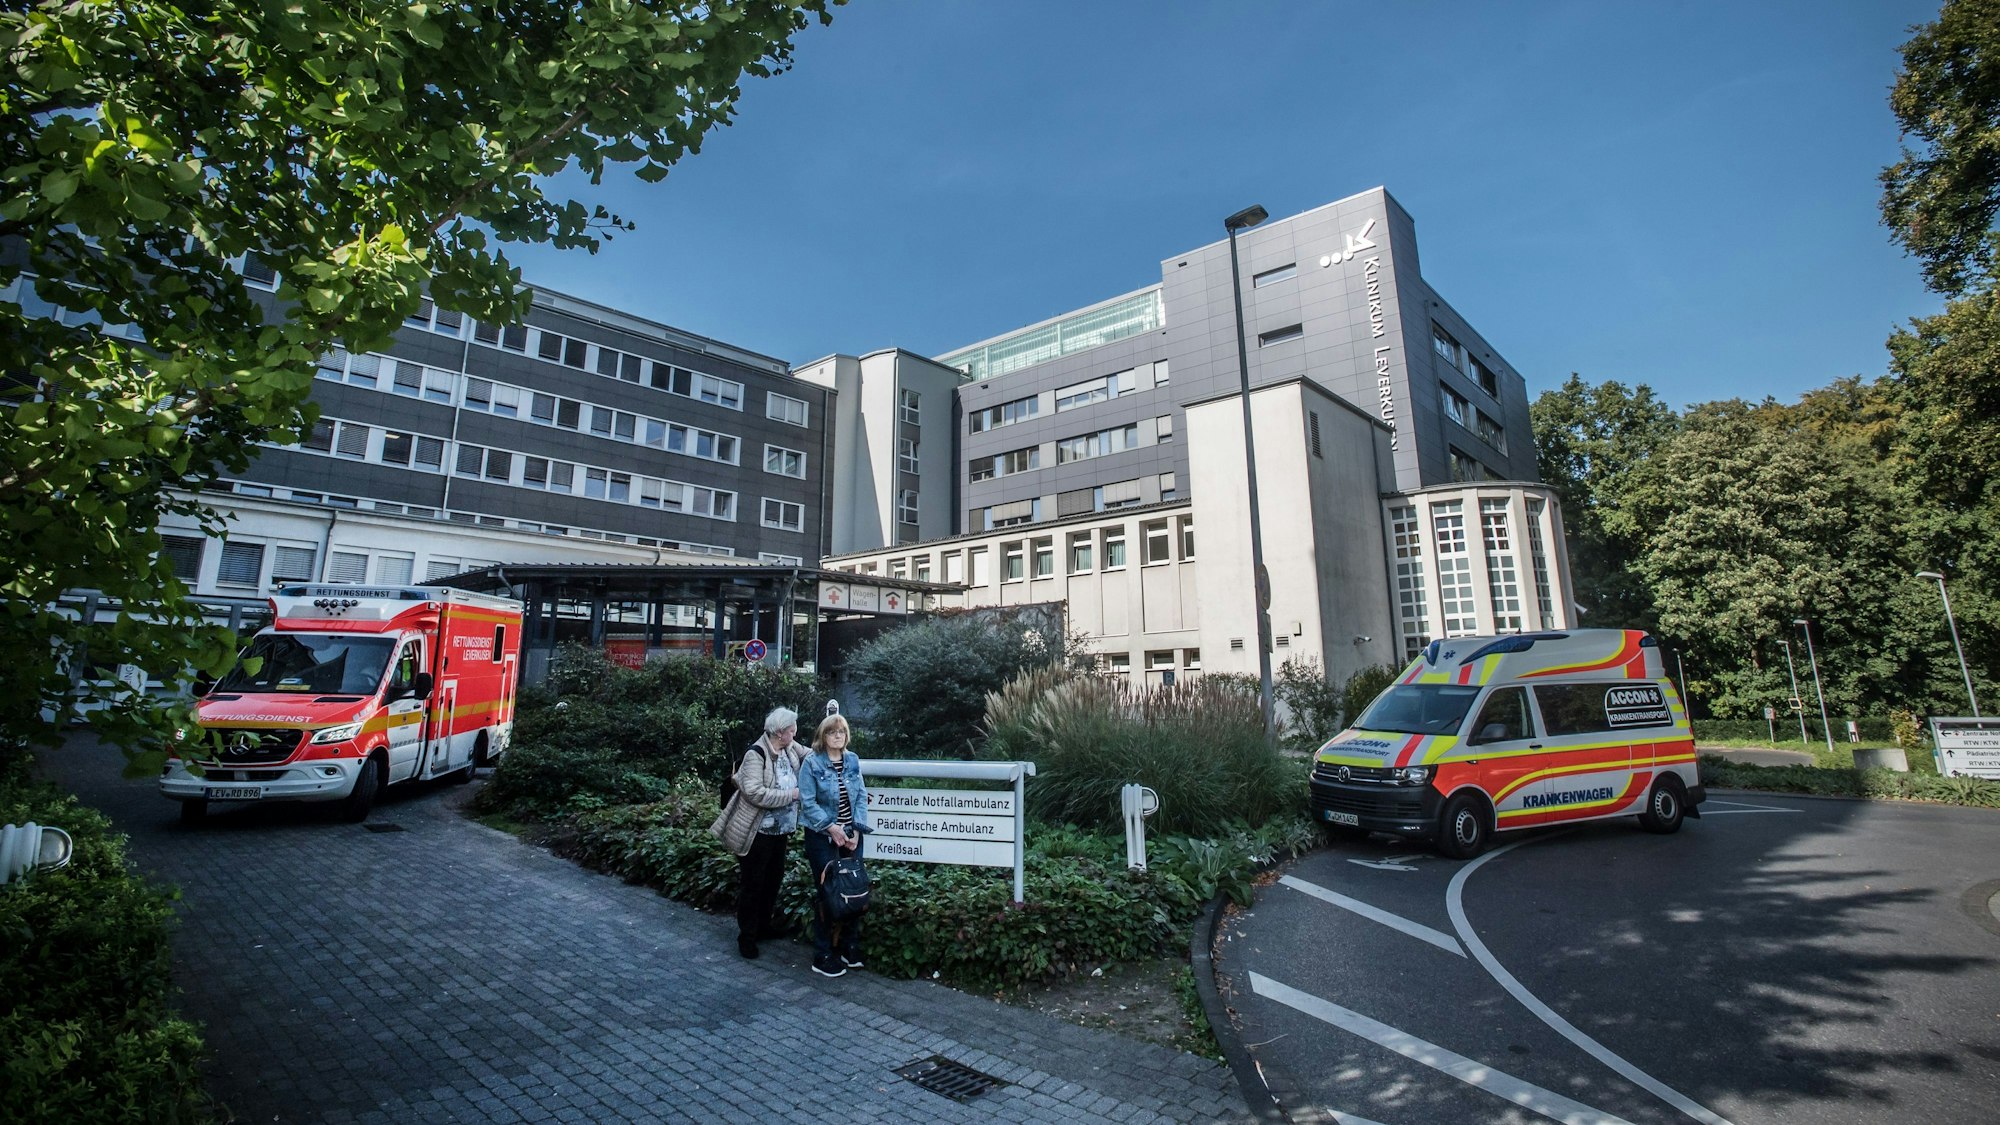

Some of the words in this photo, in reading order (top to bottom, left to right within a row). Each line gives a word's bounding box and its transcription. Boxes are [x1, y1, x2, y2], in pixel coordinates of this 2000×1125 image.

[1364, 256, 1384, 339] KLINIKUM
[1374, 346, 1398, 452] LEVERKUSN
[316, 588, 391, 598] RETTUNGSDIENST
[852, 588, 876, 599] Wagen-
[852, 599, 868, 607] halle
[453, 635, 493, 648] RETTUNGSDIENST
[463, 649, 491, 661] LEVERKUSEN
[1610, 690, 1651, 705] ACCON
[1609, 711, 1668, 722] KRANKENTRANSPORT
[210, 789, 226, 798] LEV
[244, 788, 259, 798] 896
[1523, 787, 1613, 808] KRANKENWAGEN
[878, 794, 919, 806] Zentrale
[922, 796, 1010, 809] Notfallambulanz
[877, 818, 938, 832] Pädiatrische
[940, 821, 994, 834] Ambulanz
[876, 842, 923, 856] Kreißsaal
